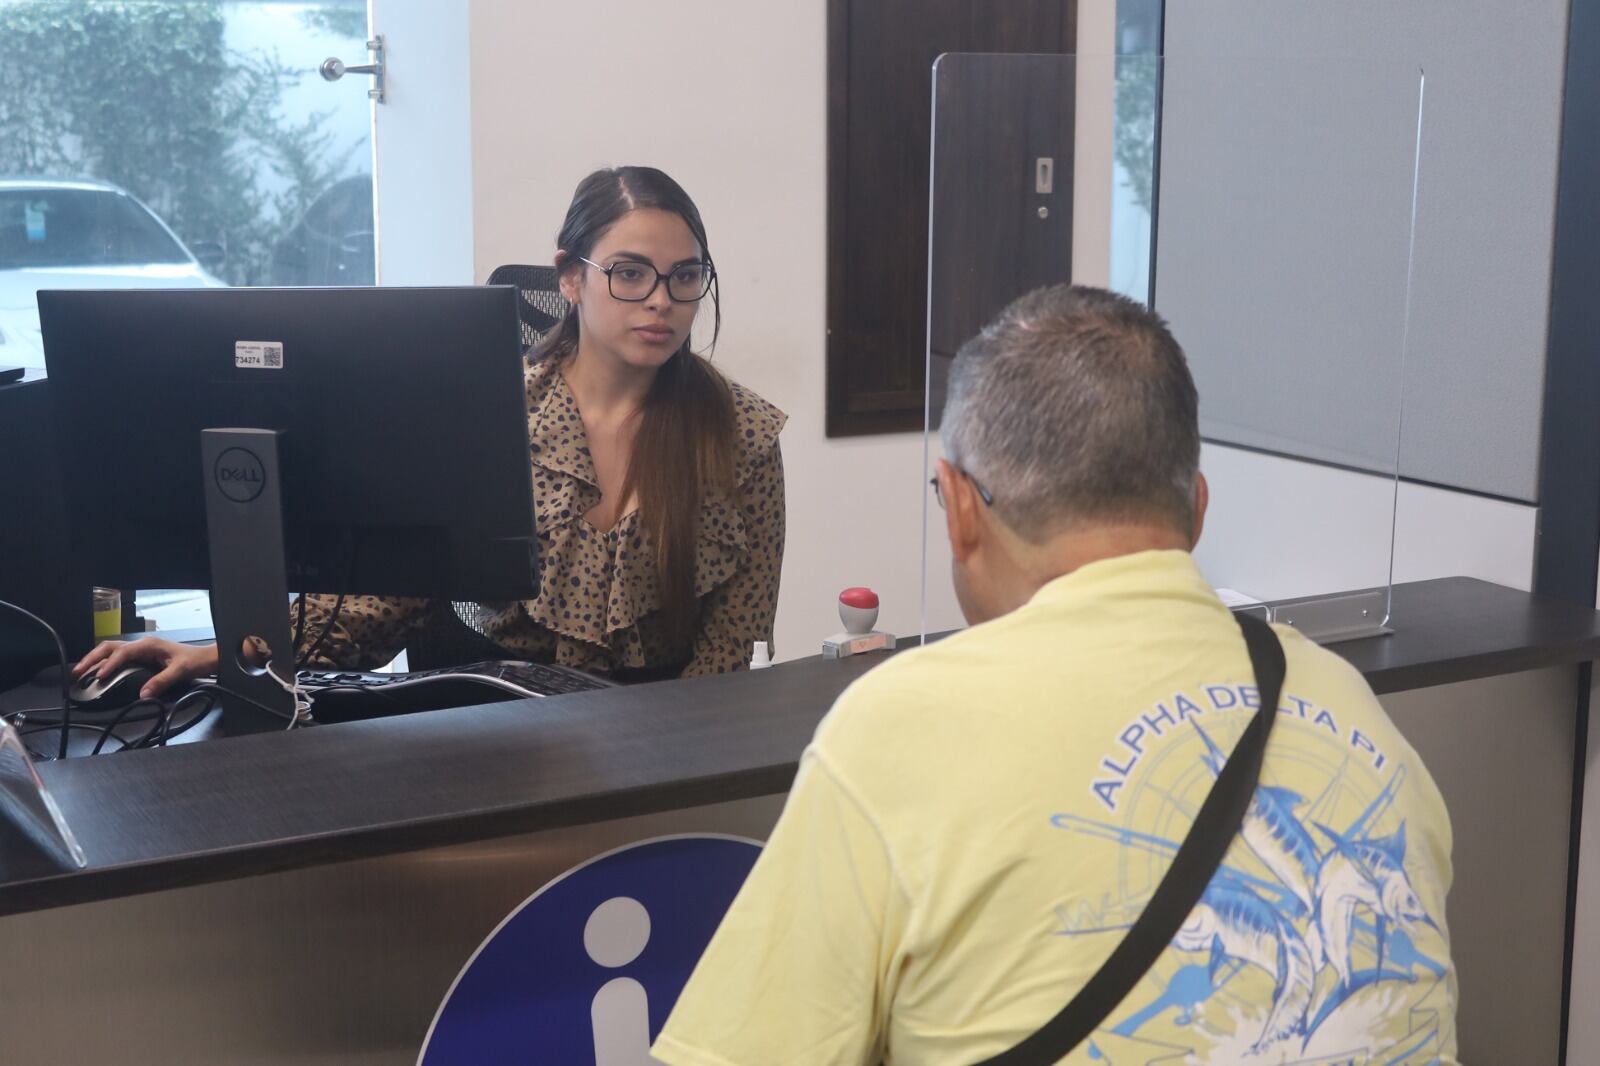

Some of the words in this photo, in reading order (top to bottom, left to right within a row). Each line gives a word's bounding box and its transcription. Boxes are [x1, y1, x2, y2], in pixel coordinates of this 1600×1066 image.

[221, 468, 261, 482] DELL
[1092, 694, 1202, 809] ALPHA
[1350, 730, 1385, 769] PI
